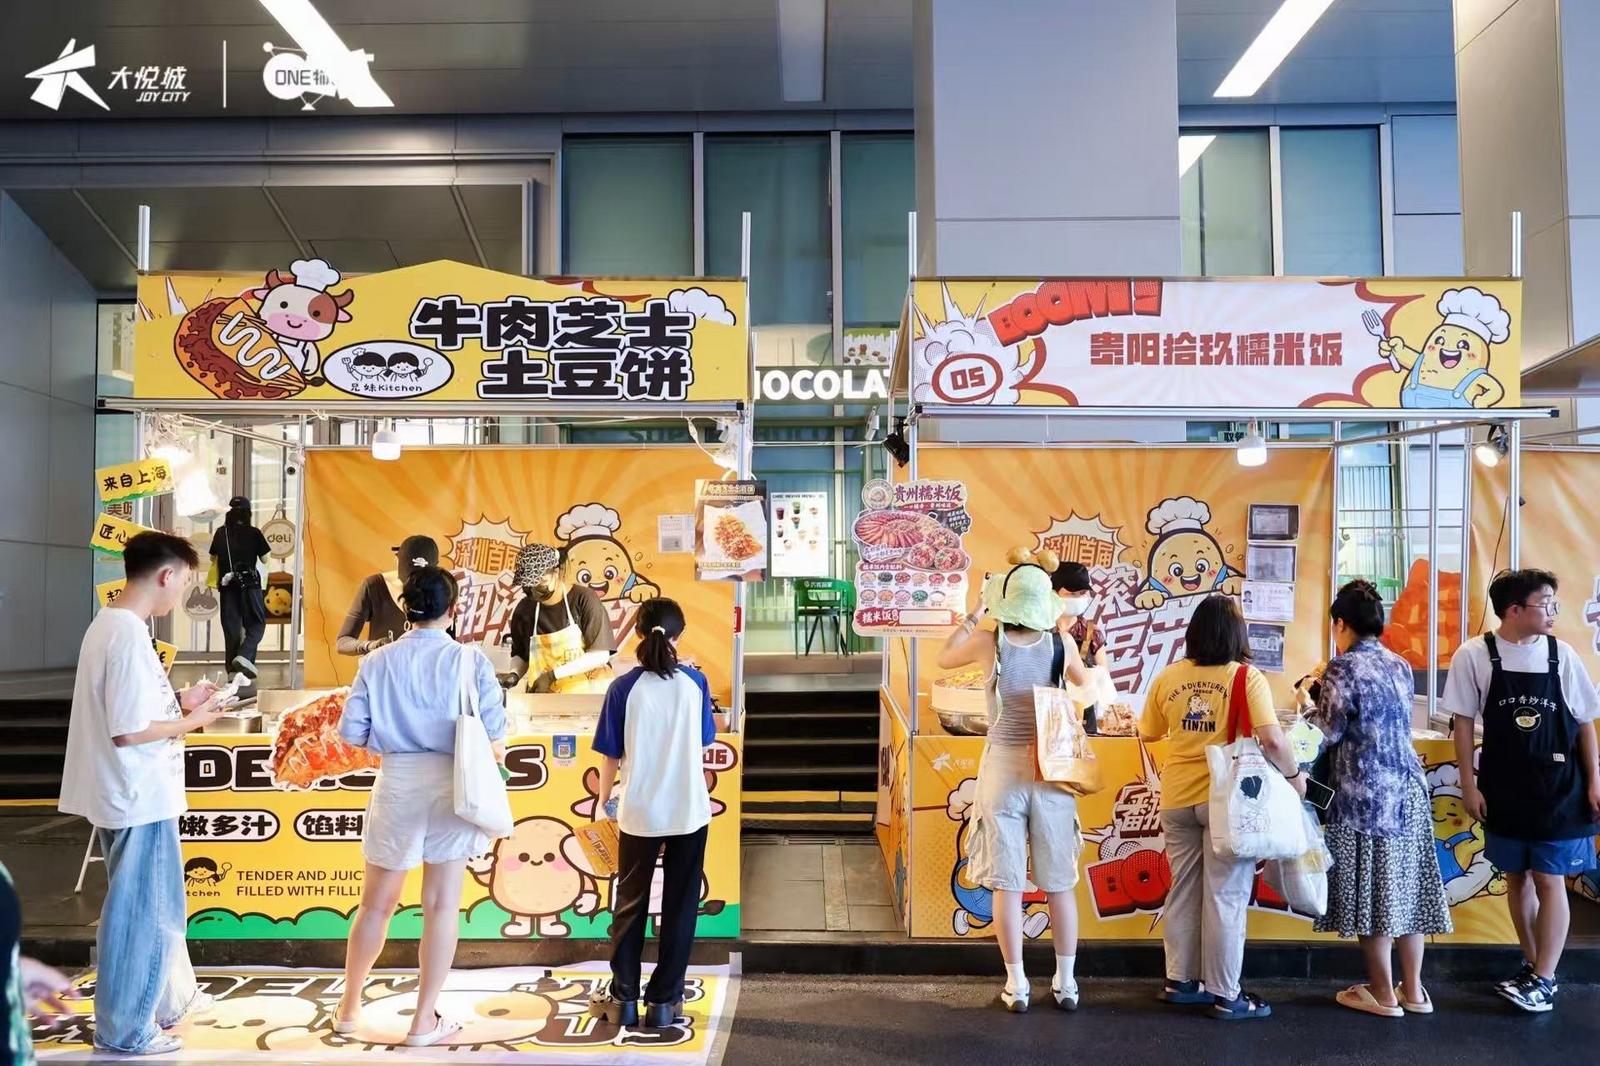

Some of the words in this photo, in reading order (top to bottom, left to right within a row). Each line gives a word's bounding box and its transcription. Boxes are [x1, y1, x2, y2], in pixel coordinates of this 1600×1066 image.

[413, 298, 694, 350] 牛肉芝士
[1090, 332, 1343, 367] 贵阳拾玖糯米饭
[481, 350, 692, 398] 土豆饼
[950, 366, 986, 391] 05
[378, 384, 423, 392] Kitchen
[103, 465, 167, 492] 来自上海
[266, 533, 293, 544] deli
[1168, 689, 1180, 703] THE
[1181, 719, 1216, 733] TINTIN
[237, 870, 294, 882] TENDER
[296, 870, 327, 881] AND
[330, 870, 365, 882] JUIC
[237, 885, 284, 897] FILLED
[287, 885, 324, 897] WITH
